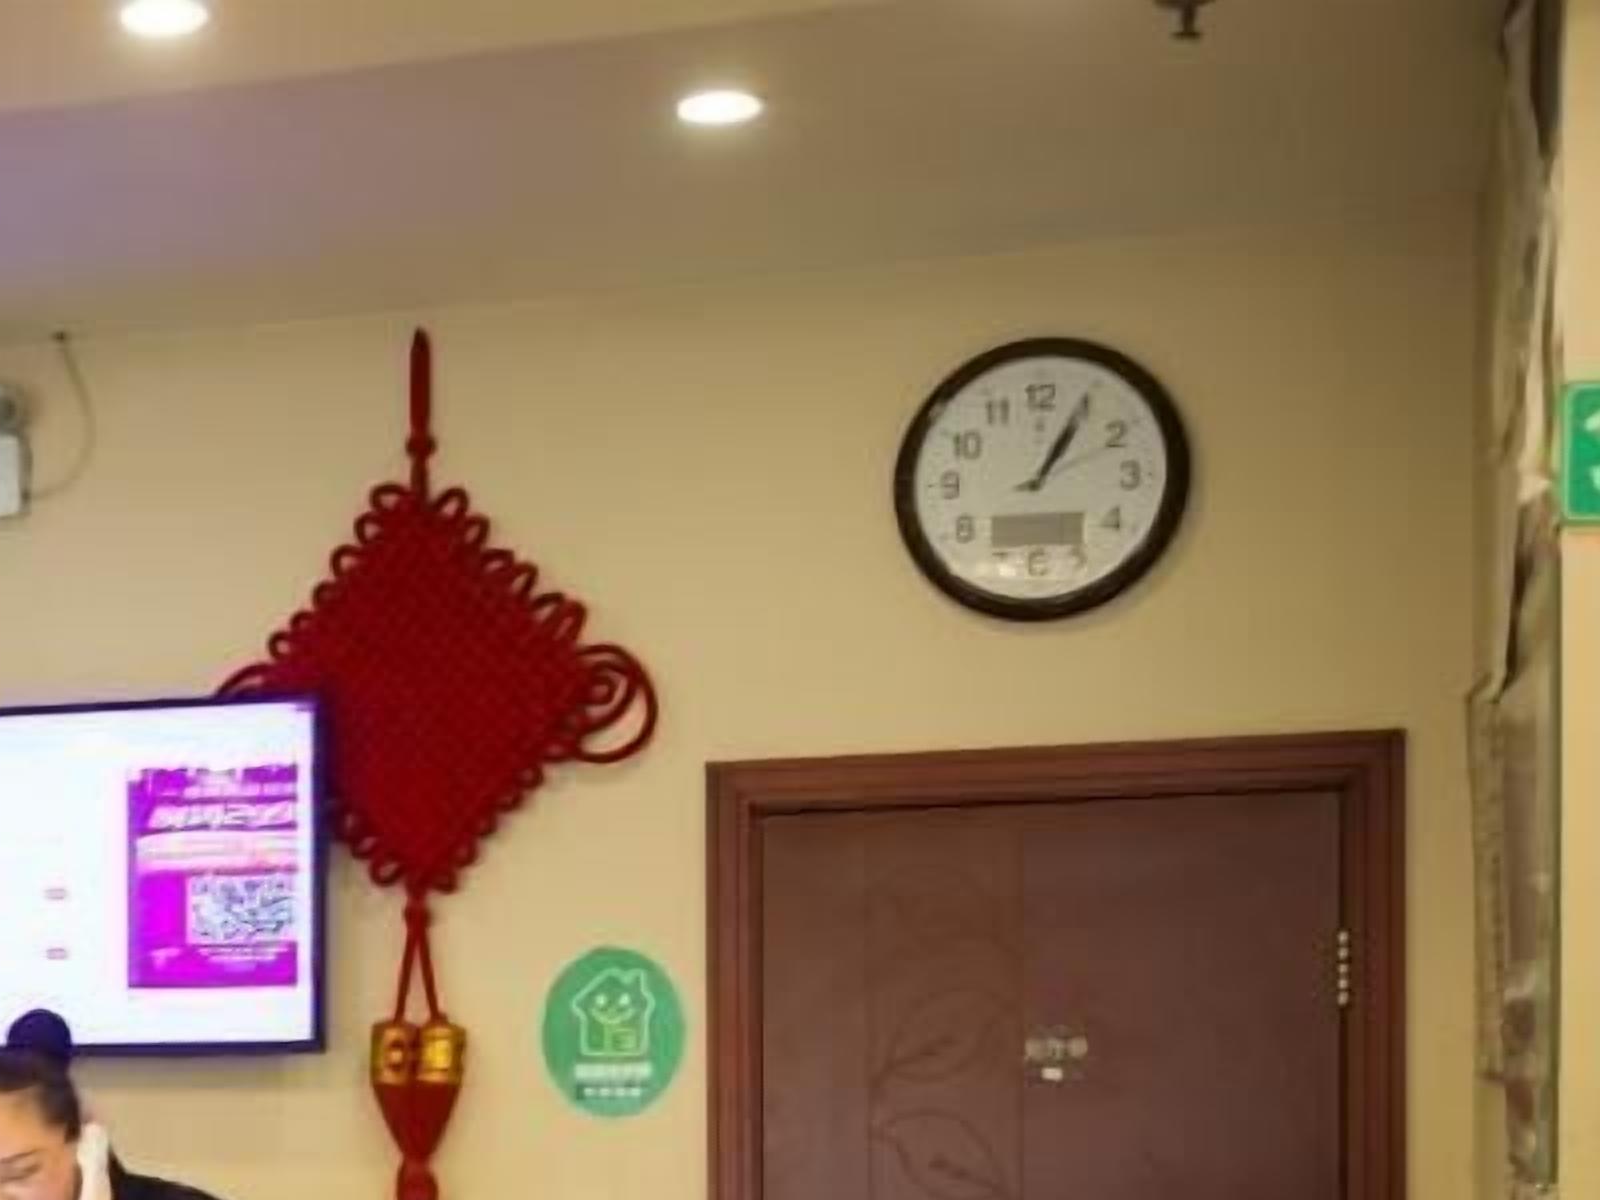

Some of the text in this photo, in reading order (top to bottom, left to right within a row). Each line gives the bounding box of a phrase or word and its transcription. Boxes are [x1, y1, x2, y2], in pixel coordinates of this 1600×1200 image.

[985, 399, 1010, 425] 11
[1024, 383, 1057, 412] 12
[952, 430, 982, 460] 10
[1104, 420, 1128, 449] 2
[939, 471, 961, 500] 9
[1119, 460, 1142, 490] 3
[955, 514, 976, 544] 8
[1099, 505, 1122, 532] 4
